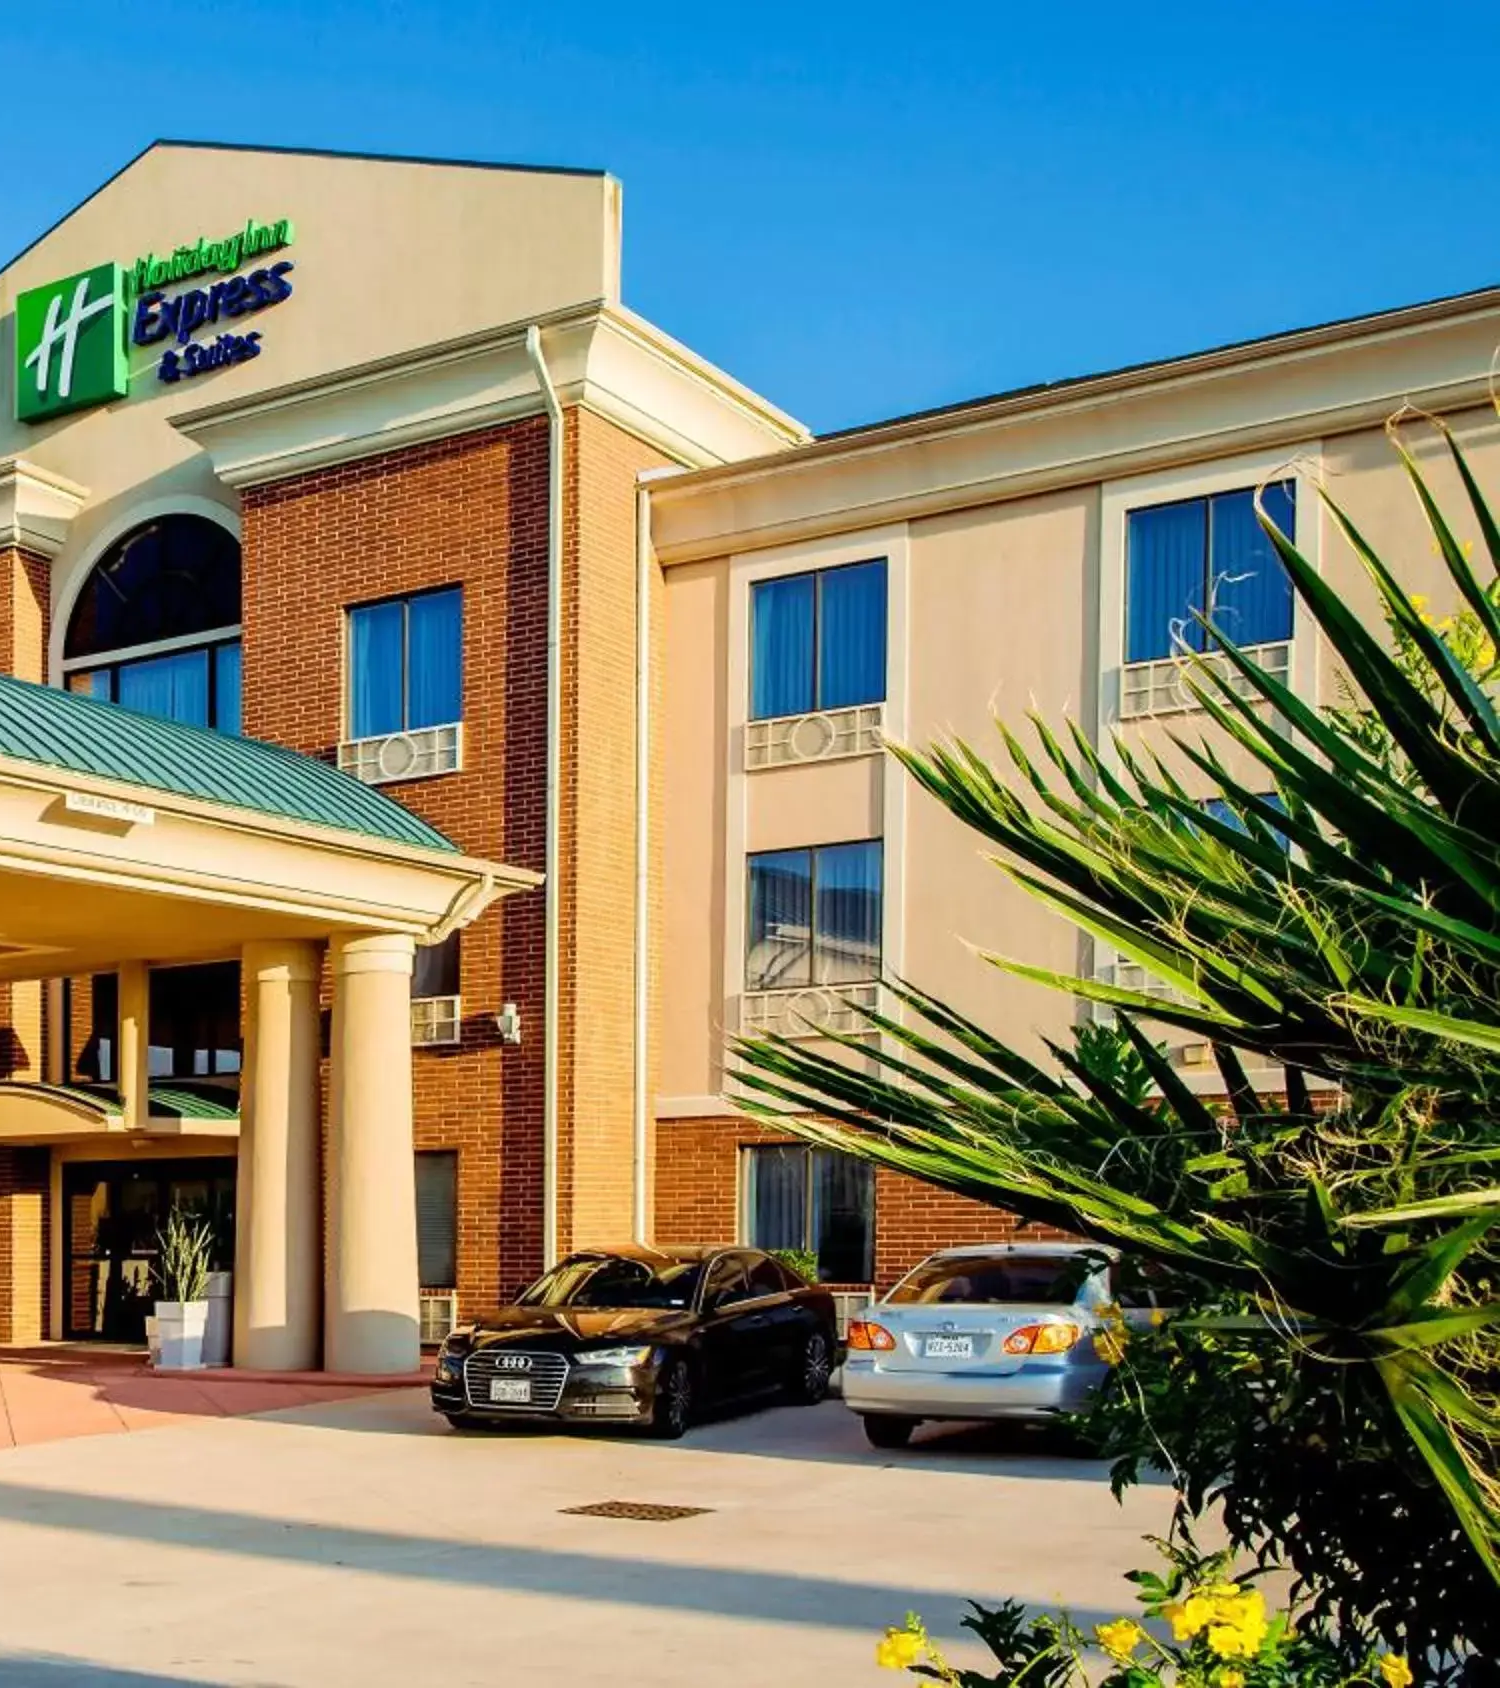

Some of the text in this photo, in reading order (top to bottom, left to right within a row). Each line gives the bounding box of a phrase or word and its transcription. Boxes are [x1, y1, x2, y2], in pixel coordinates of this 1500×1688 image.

[132, 219, 294, 294] Holiday Inn
[133, 262, 294, 346] Express
[158, 331, 263, 382] & Suites
